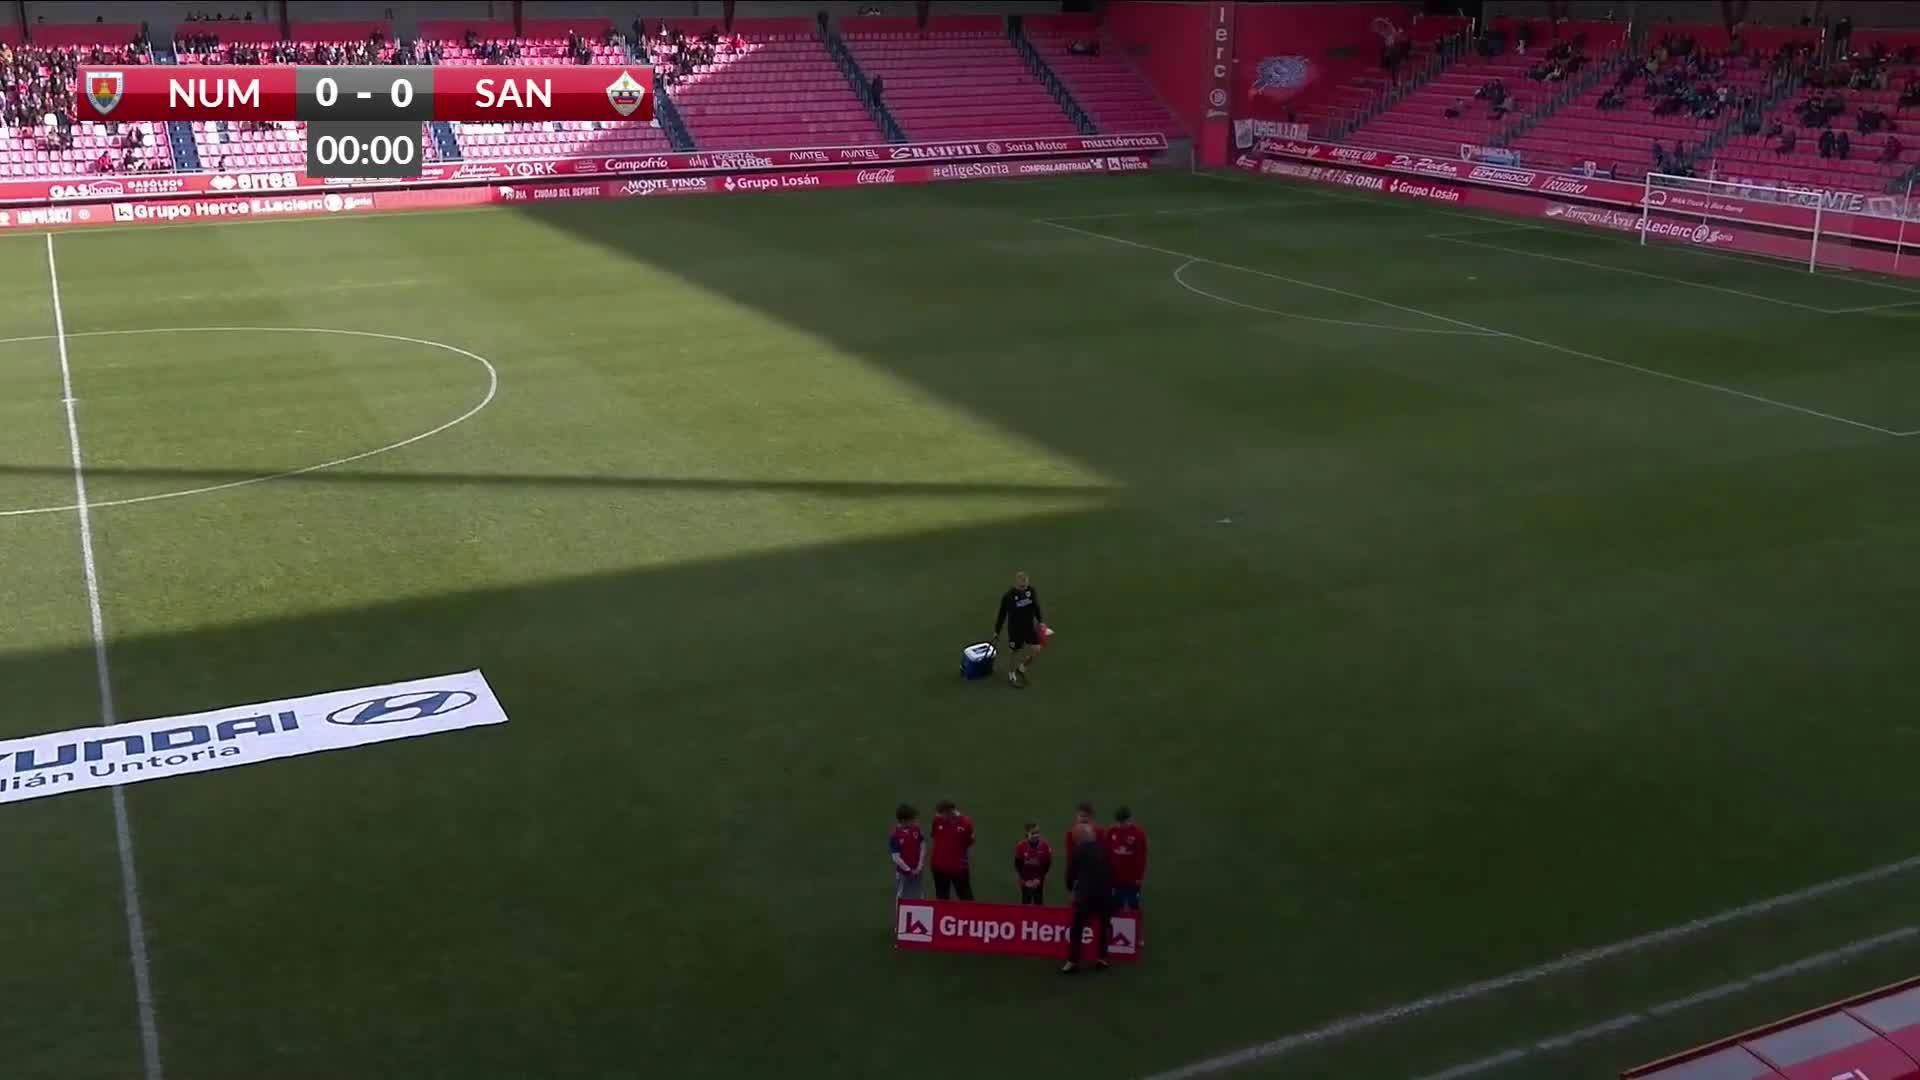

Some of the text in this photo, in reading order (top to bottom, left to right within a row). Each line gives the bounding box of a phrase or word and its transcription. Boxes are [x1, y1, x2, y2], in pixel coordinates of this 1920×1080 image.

[1006, 141, 1068, 152] Soria Motor
[504, 162, 558, 177] YORK
[713, 158, 773, 169] LATORRE
[933, 163, 1009, 180] #eligeSoria
[628, 179, 669, 191] MONTE
[672, 177, 707, 188] PINOS
[737, 174, 820, 191] Grupo Losán
[1399, 181, 1460, 201] Grupo Losán
[135, 201, 249, 220] Grupo Herce
[0, 711, 301, 773] UNDAI
[90, 746, 241, 778] Untoria
[939, 916, 1015, 943] Grupo
